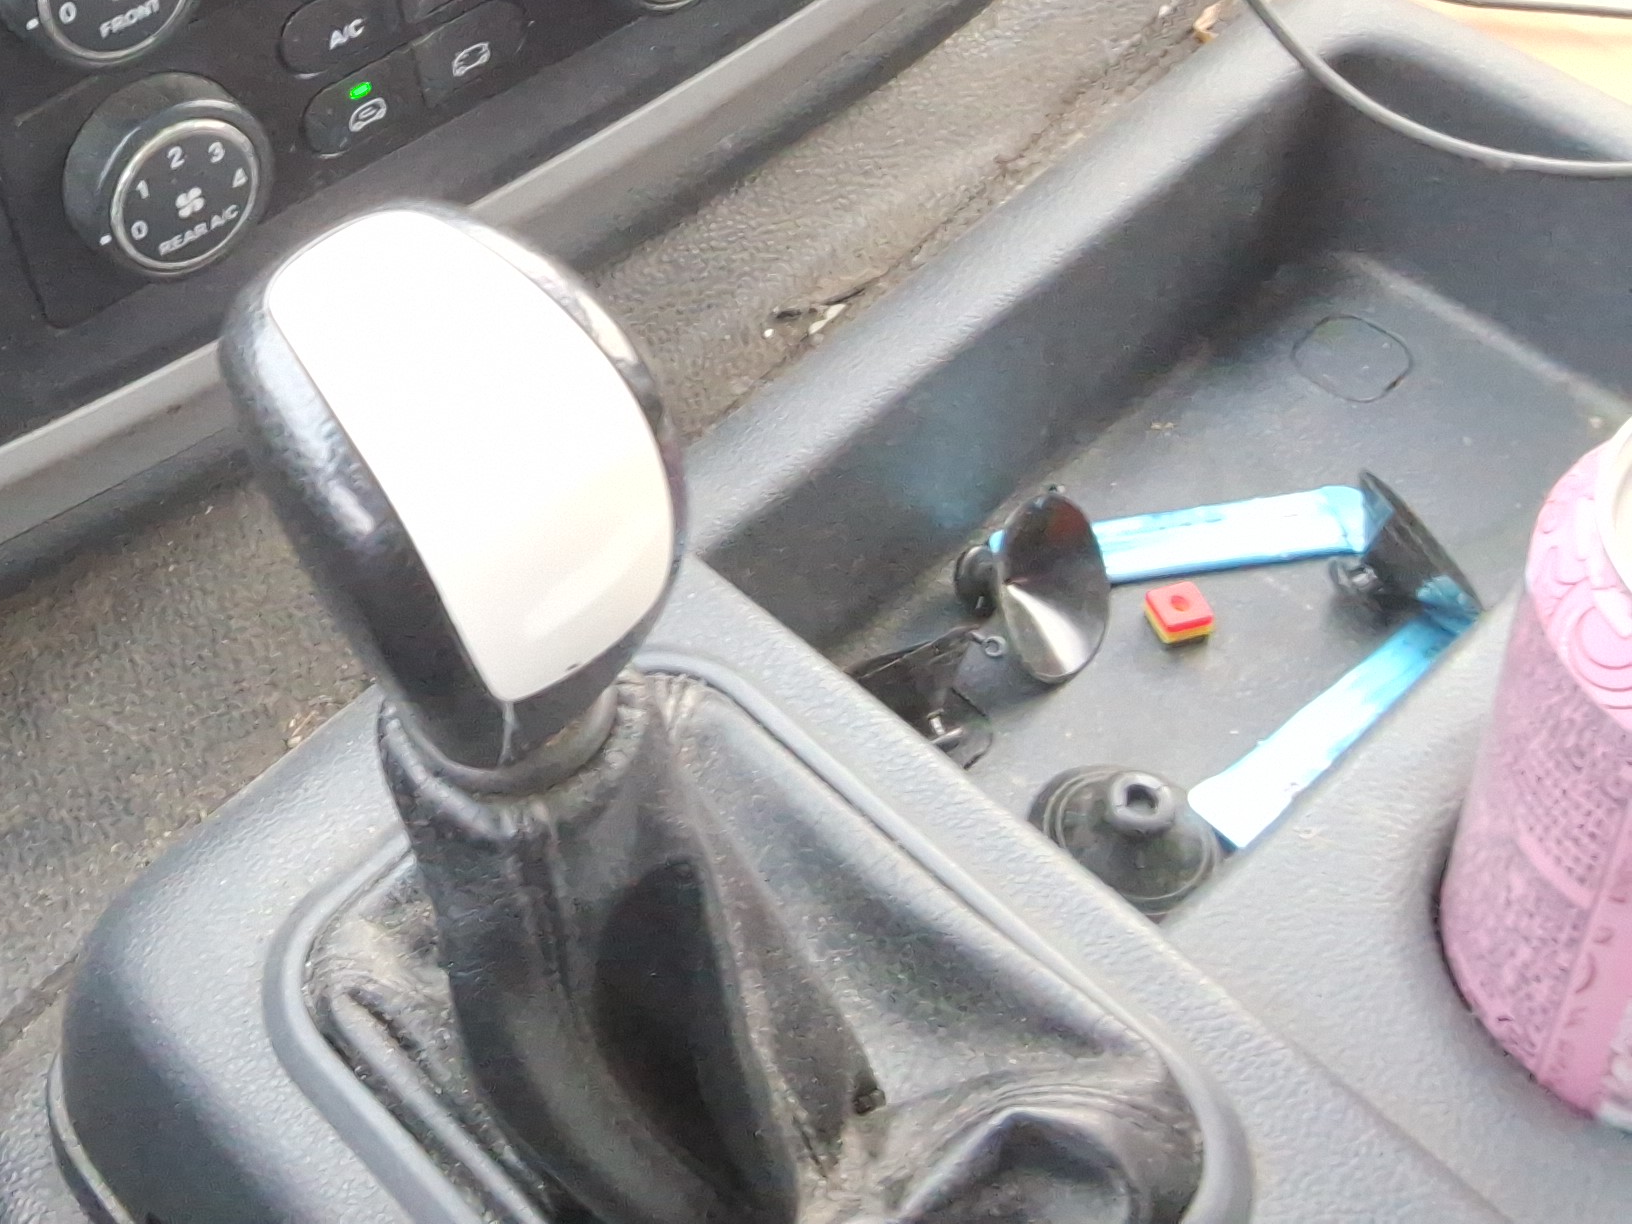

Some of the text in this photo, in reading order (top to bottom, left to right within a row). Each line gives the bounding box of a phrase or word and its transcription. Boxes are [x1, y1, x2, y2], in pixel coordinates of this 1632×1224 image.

[59, 1, 77, 24] 0
[329, 18, 366, 50] A/C
[167, 146, 185, 170] 2
[208, 142, 225, 163] 3
[136, 179, 150, 199] 1
[232, 168, 248, 188] 4
[131, 220, 148, 240] 0
[158, 222, 208, 256] REAR
